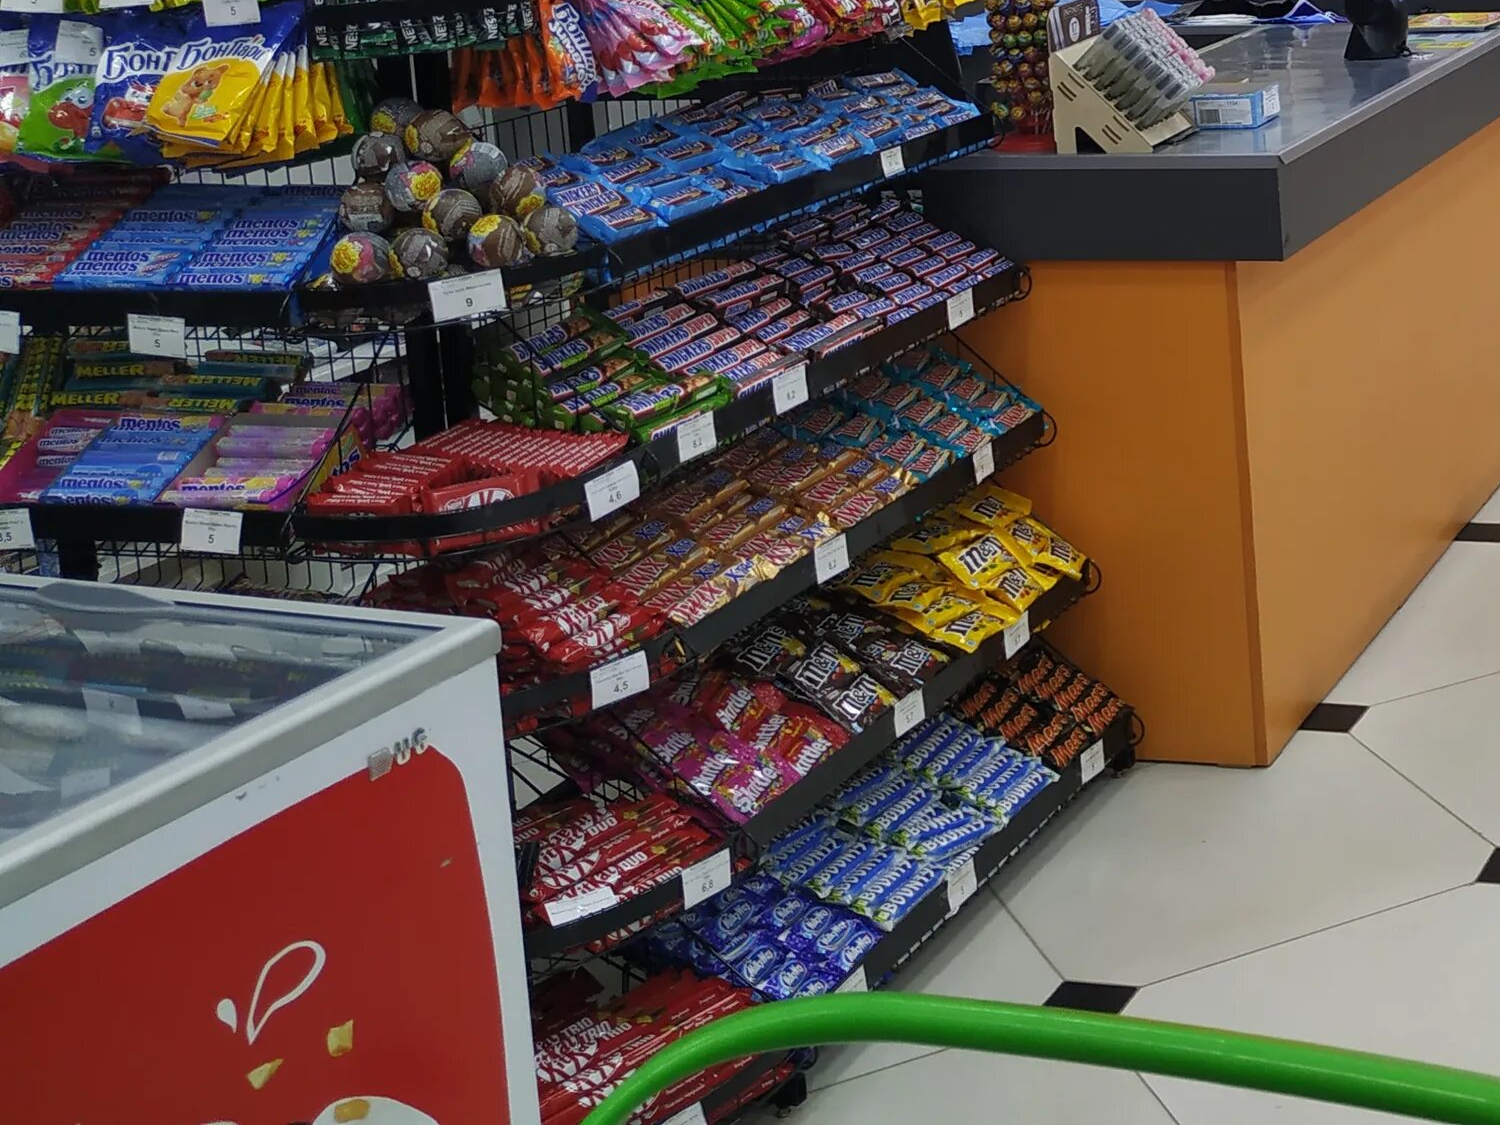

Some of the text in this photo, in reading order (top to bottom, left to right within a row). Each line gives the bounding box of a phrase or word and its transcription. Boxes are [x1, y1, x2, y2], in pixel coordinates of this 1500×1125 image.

[230, 6, 236, 16] 5
[90, 48, 96, 57] 5
[180, 37, 267, 68] БонПари
[84, 250, 151, 262] mentos
[202, 252, 267, 263] mentos
[178, 273, 245, 284] mentos
[466, 297, 473, 307] 9
[638, 314, 717, 358] SNICKERS SUPER
[154, 339, 160, 348] 5
[663, 329, 741, 373] SNICKERS SUPER
[739, 340, 766, 361] SUPER
[76, 364, 145, 377] MELLER
[51, 393, 119, 406] MELLER
[61, 478, 127, 489] mentos
[608, 490, 622, 504] 4,6
[208, 534, 214, 544] 5
[614, 680, 629, 694] 4,5
[588, 815, 618, 839] DUO
[621, 850, 648, 873] DUO
[701, 879, 714, 893] 6,8
